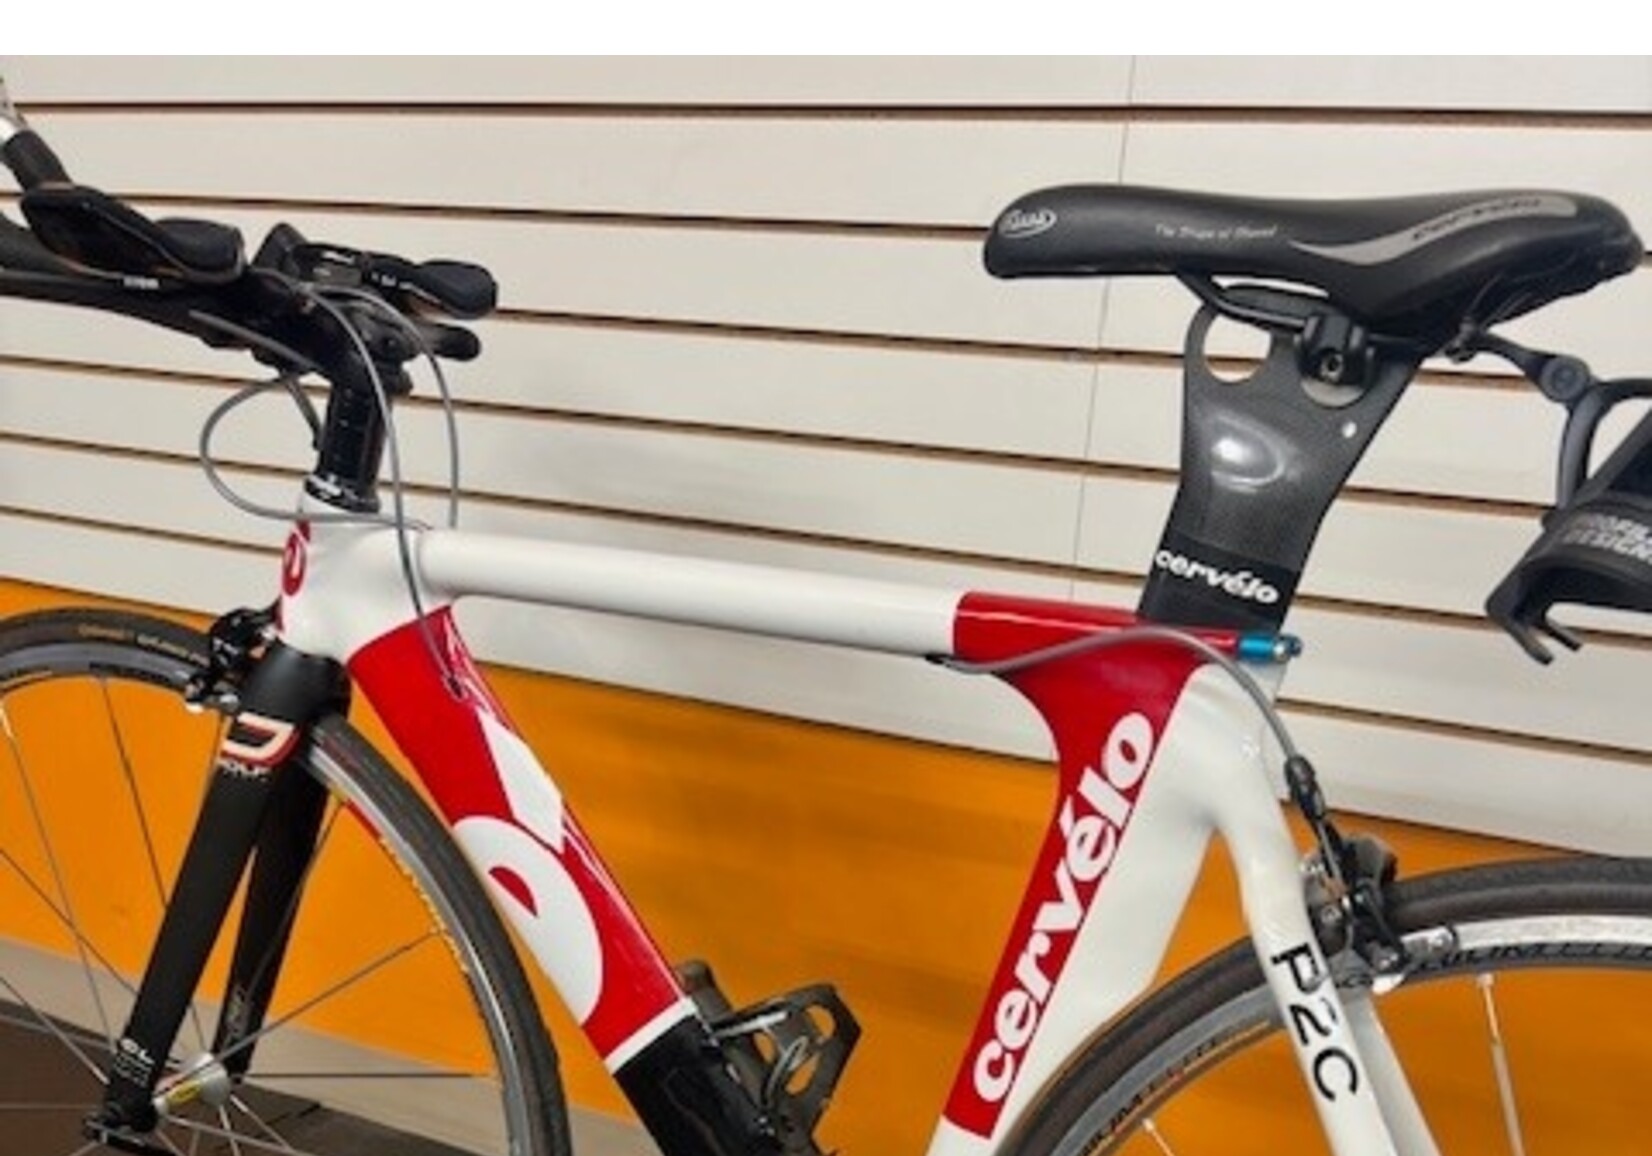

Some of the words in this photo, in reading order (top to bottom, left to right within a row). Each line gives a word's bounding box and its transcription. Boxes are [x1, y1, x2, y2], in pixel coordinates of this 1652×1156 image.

[1155, 550, 1279, 603] cervélo
[972, 712, 1155, 1102] cervélo
[1270, 942, 1359, 1102] P2C
